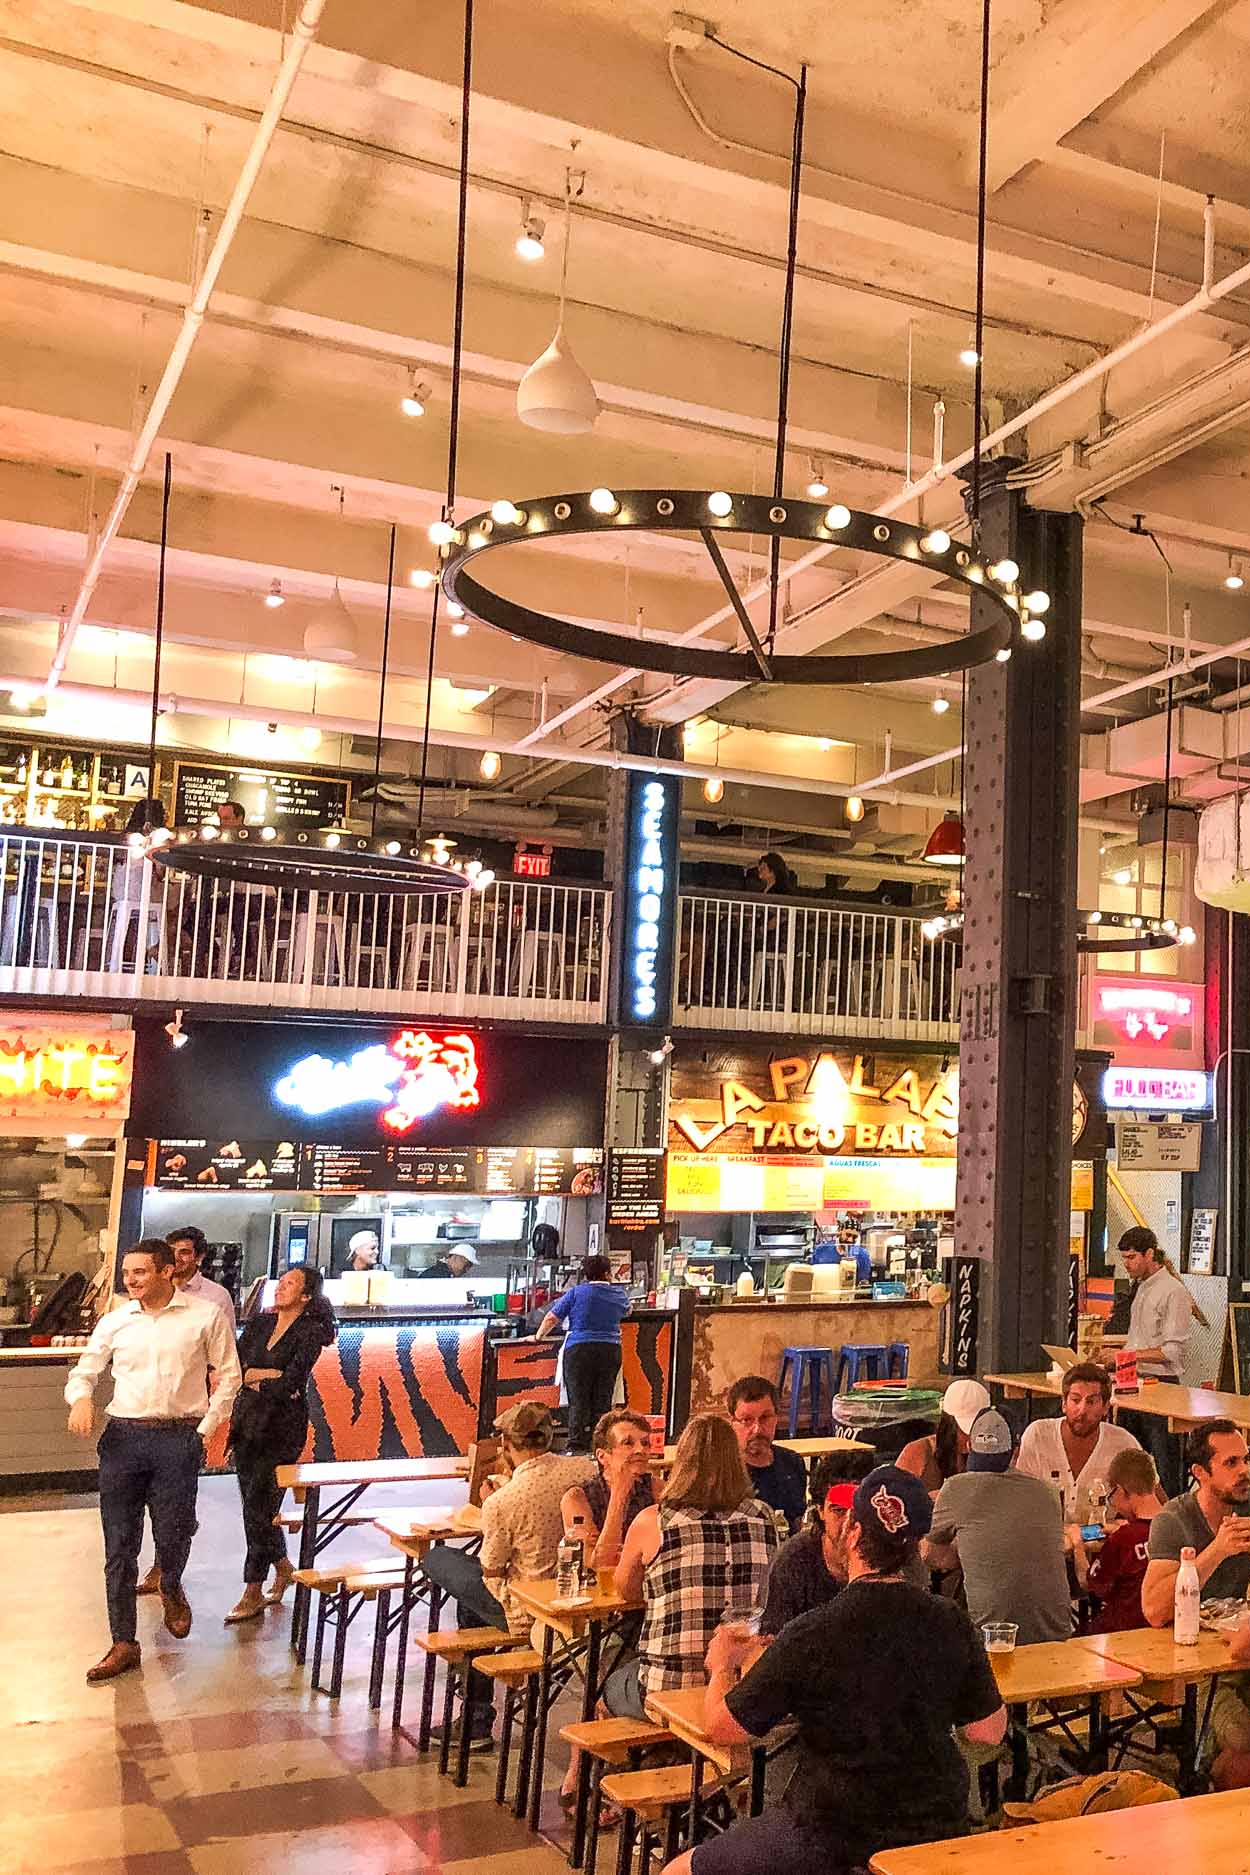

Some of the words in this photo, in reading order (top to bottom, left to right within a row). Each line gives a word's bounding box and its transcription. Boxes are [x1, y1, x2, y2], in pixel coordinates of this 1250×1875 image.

[131, 771, 146, 788] A
[518, 855, 550, 876] EXIT
[675, 1080, 766, 1151] LA
[747, 1120, 846, 1153] TACO
[855, 1121, 927, 1152] BAR
[956, 1264, 974, 1369] NAPKINS
